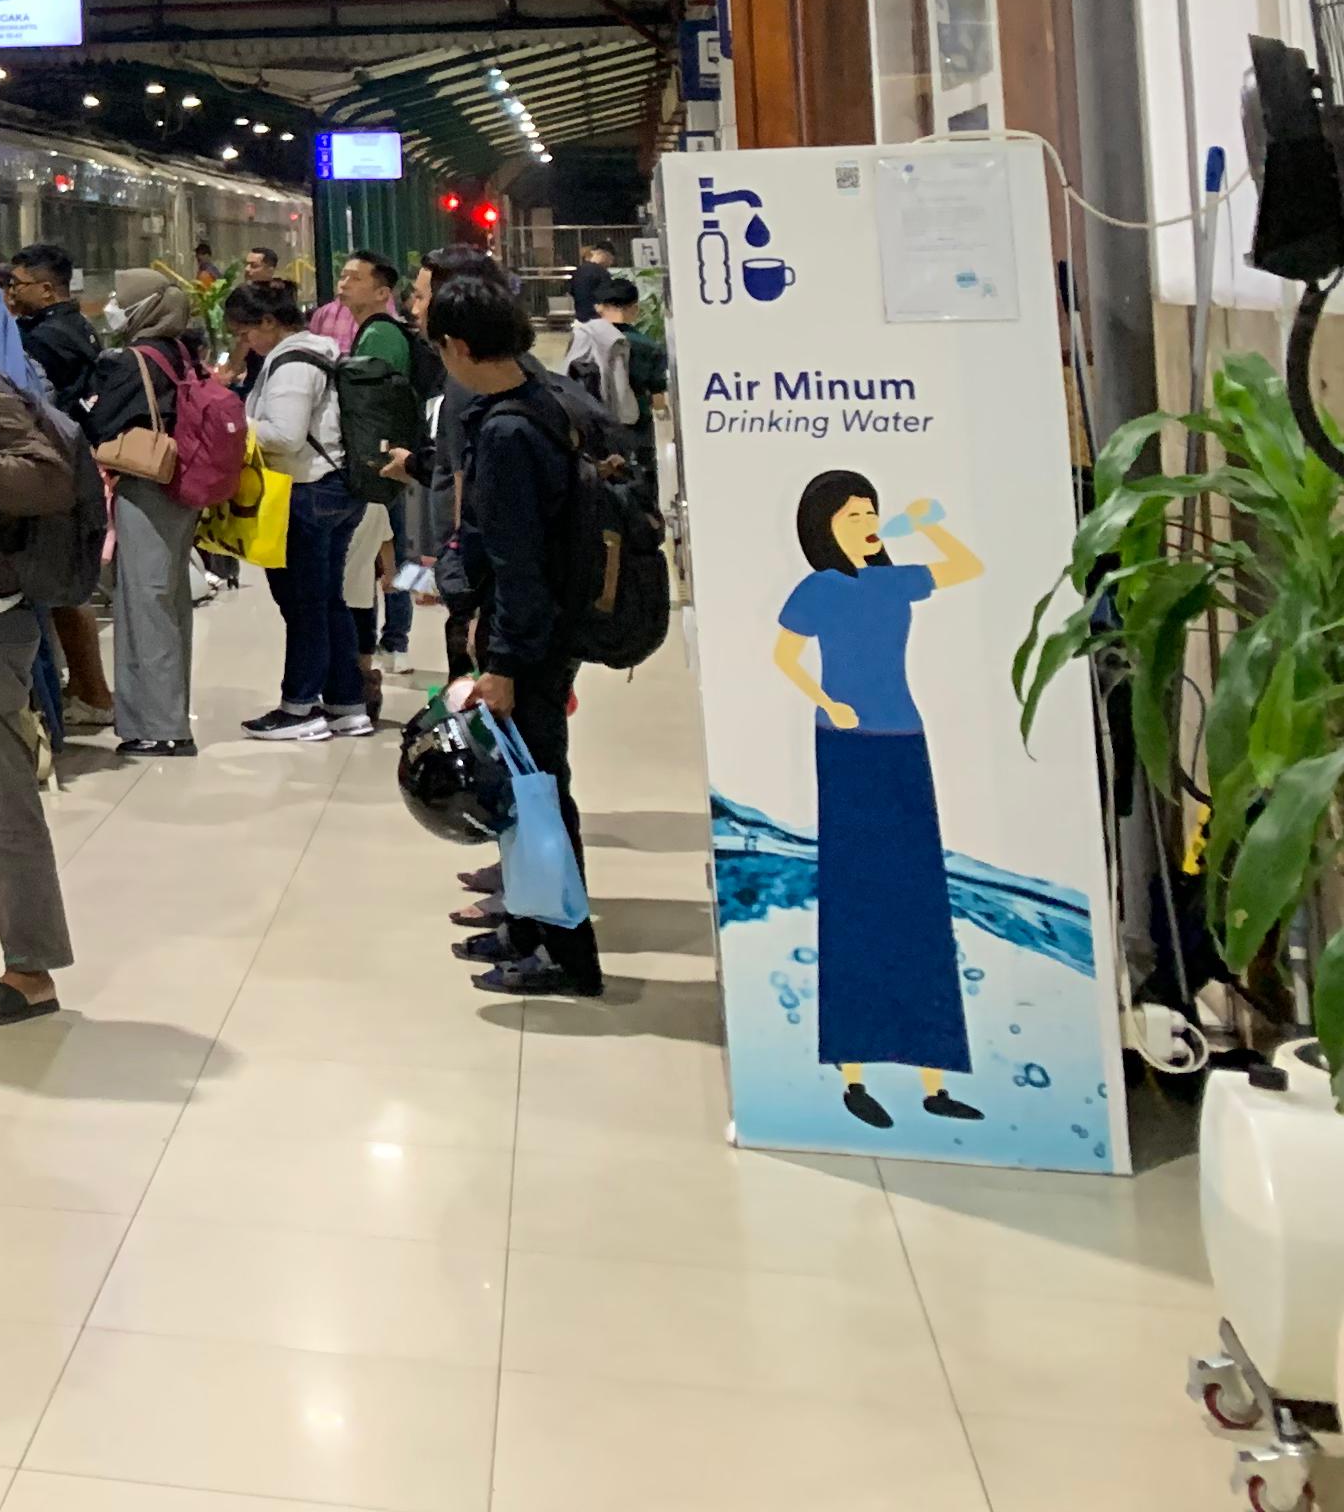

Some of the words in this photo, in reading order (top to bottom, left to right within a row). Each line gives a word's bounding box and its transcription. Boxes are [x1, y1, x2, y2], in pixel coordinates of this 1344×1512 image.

[703, 372, 760, 401] Air
[774, 370, 917, 401] Minum
[705, 410, 830, 439] Drinking
[842, 409, 934, 433] Water
